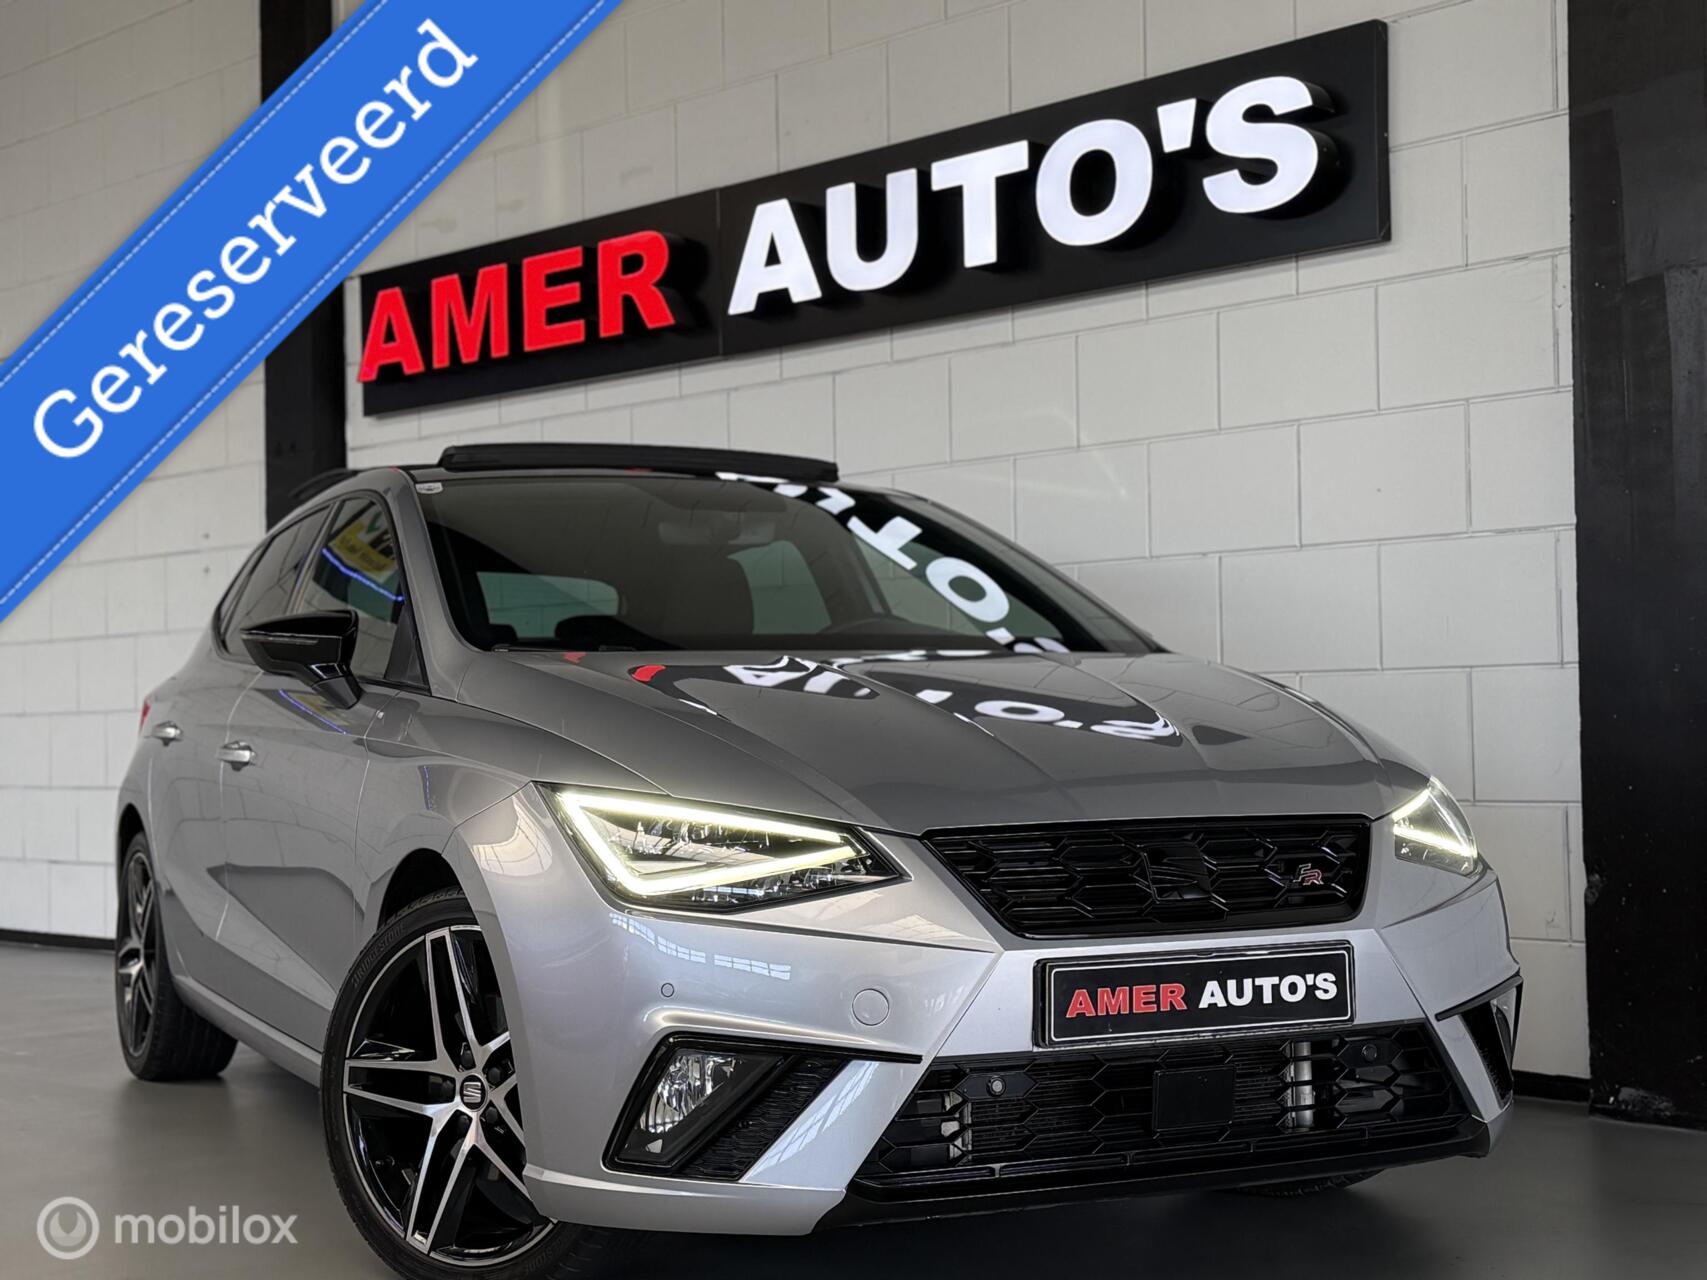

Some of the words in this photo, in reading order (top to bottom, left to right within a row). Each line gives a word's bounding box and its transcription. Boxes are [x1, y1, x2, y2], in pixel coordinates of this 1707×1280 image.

[357, 230, 675, 383] AMER
[727, 75, 1319, 315] AUTO'S
[1065, 983, 1187, 1018] AMER
[1198, 972, 1337, 1009] AUTO'S
